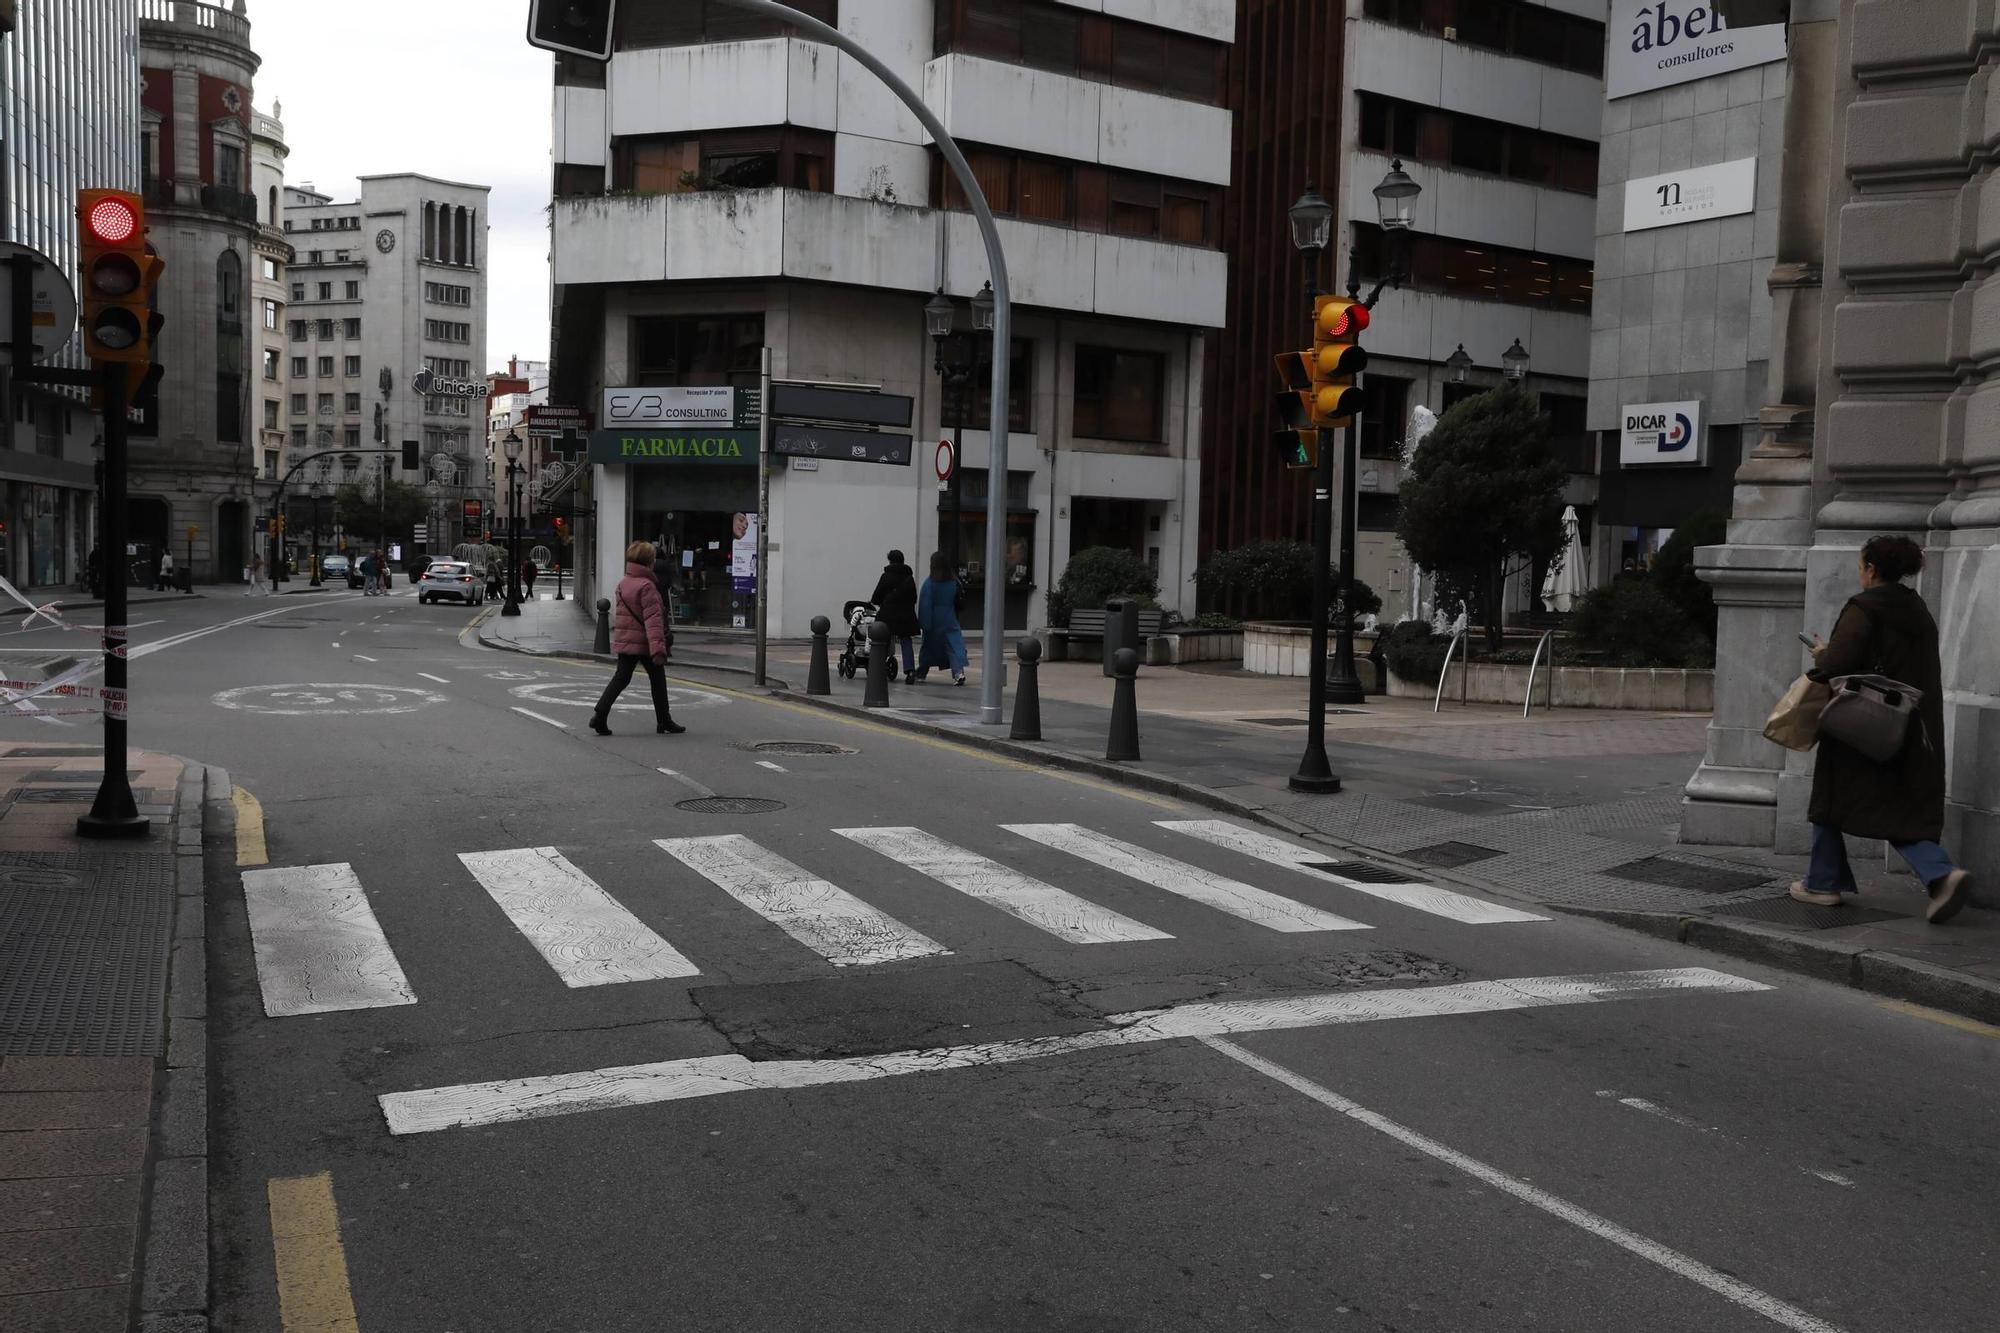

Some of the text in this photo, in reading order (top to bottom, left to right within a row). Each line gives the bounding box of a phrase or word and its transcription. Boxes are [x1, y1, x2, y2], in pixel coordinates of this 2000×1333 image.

[1657, 42, 1734, 69] consultores
[433, 377, 488, 399] Unicaja
[666, 408, 728, 418] CONSULTING
[1626, 414, 1667, 430] DICAR
[620, 437, 743, 457] FARMACIA
